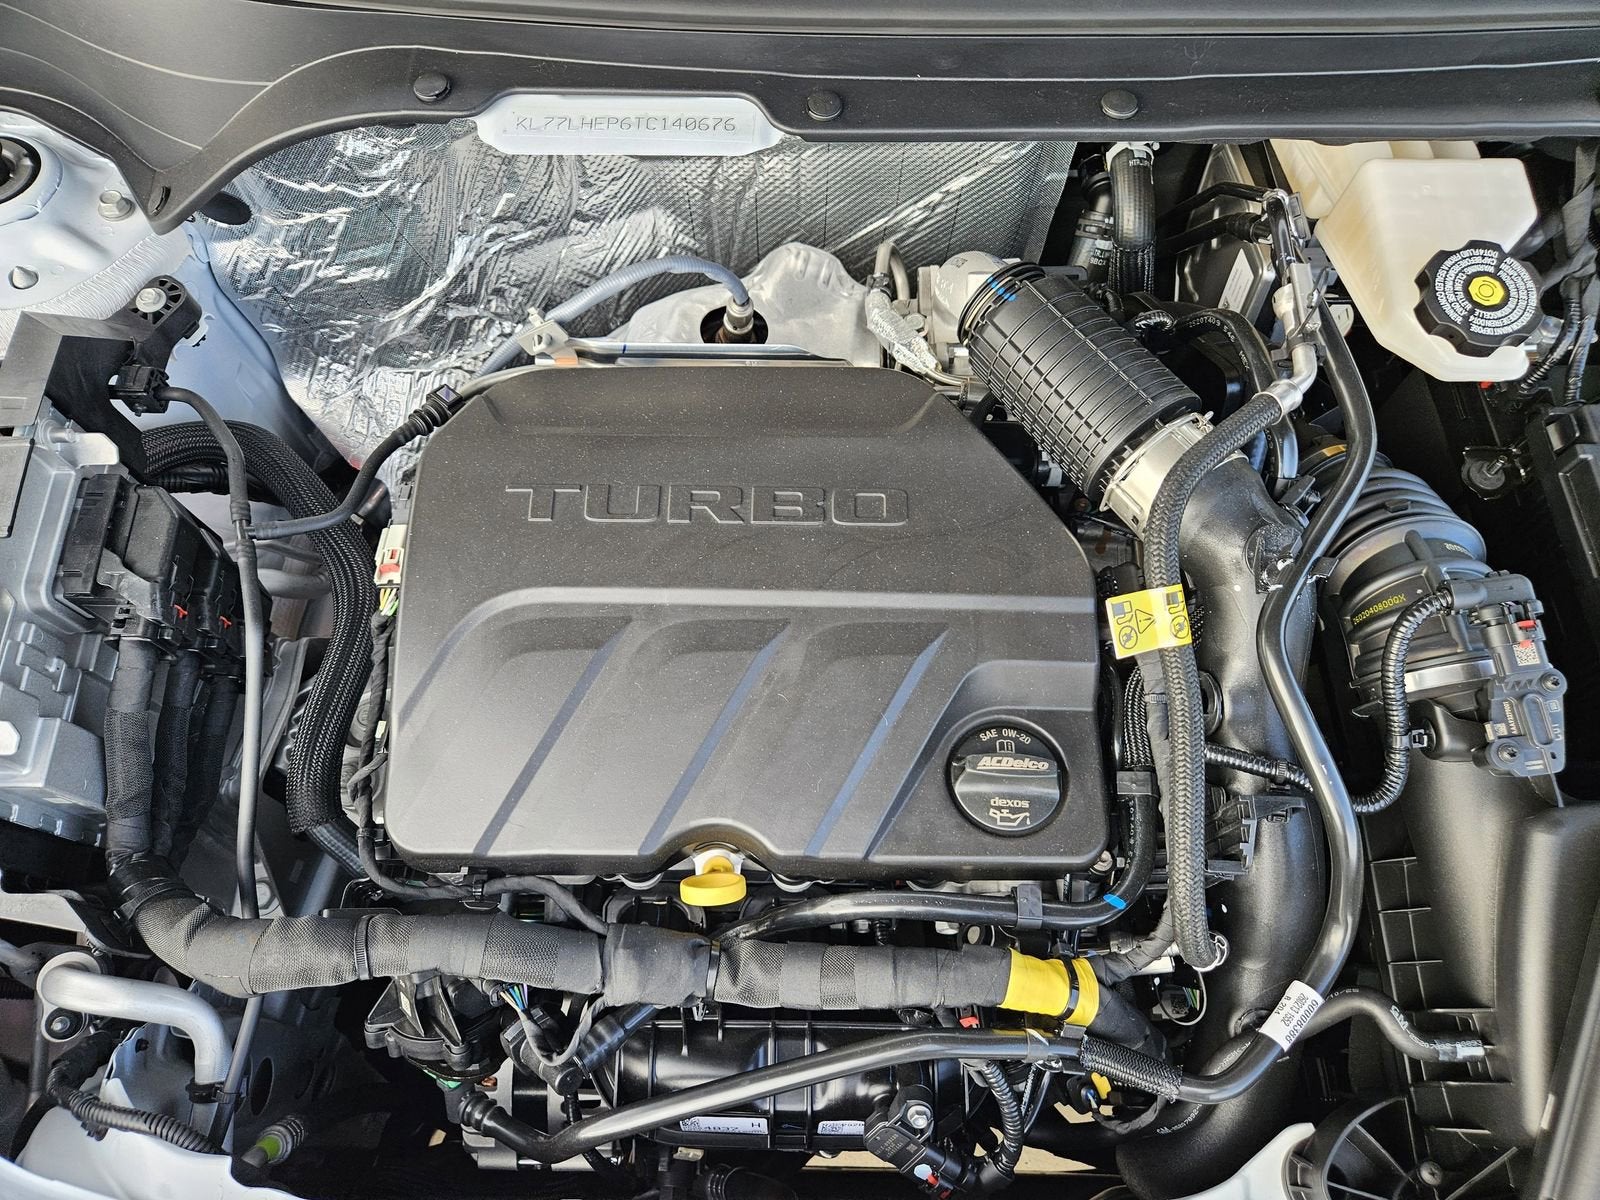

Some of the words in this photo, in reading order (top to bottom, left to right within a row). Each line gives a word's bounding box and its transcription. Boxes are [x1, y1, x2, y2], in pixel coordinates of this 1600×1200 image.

[515, 116, 737, 132] KL77LHEP6TC140676
[505, 484, 909, 526] TURBO
[980, 728, 998, 742] SAE
[1002, 728, 1032, 745] 0W-20
[976, 756, 1049, 770] ACDelco
[990, 796, 1031, 808] dexos
